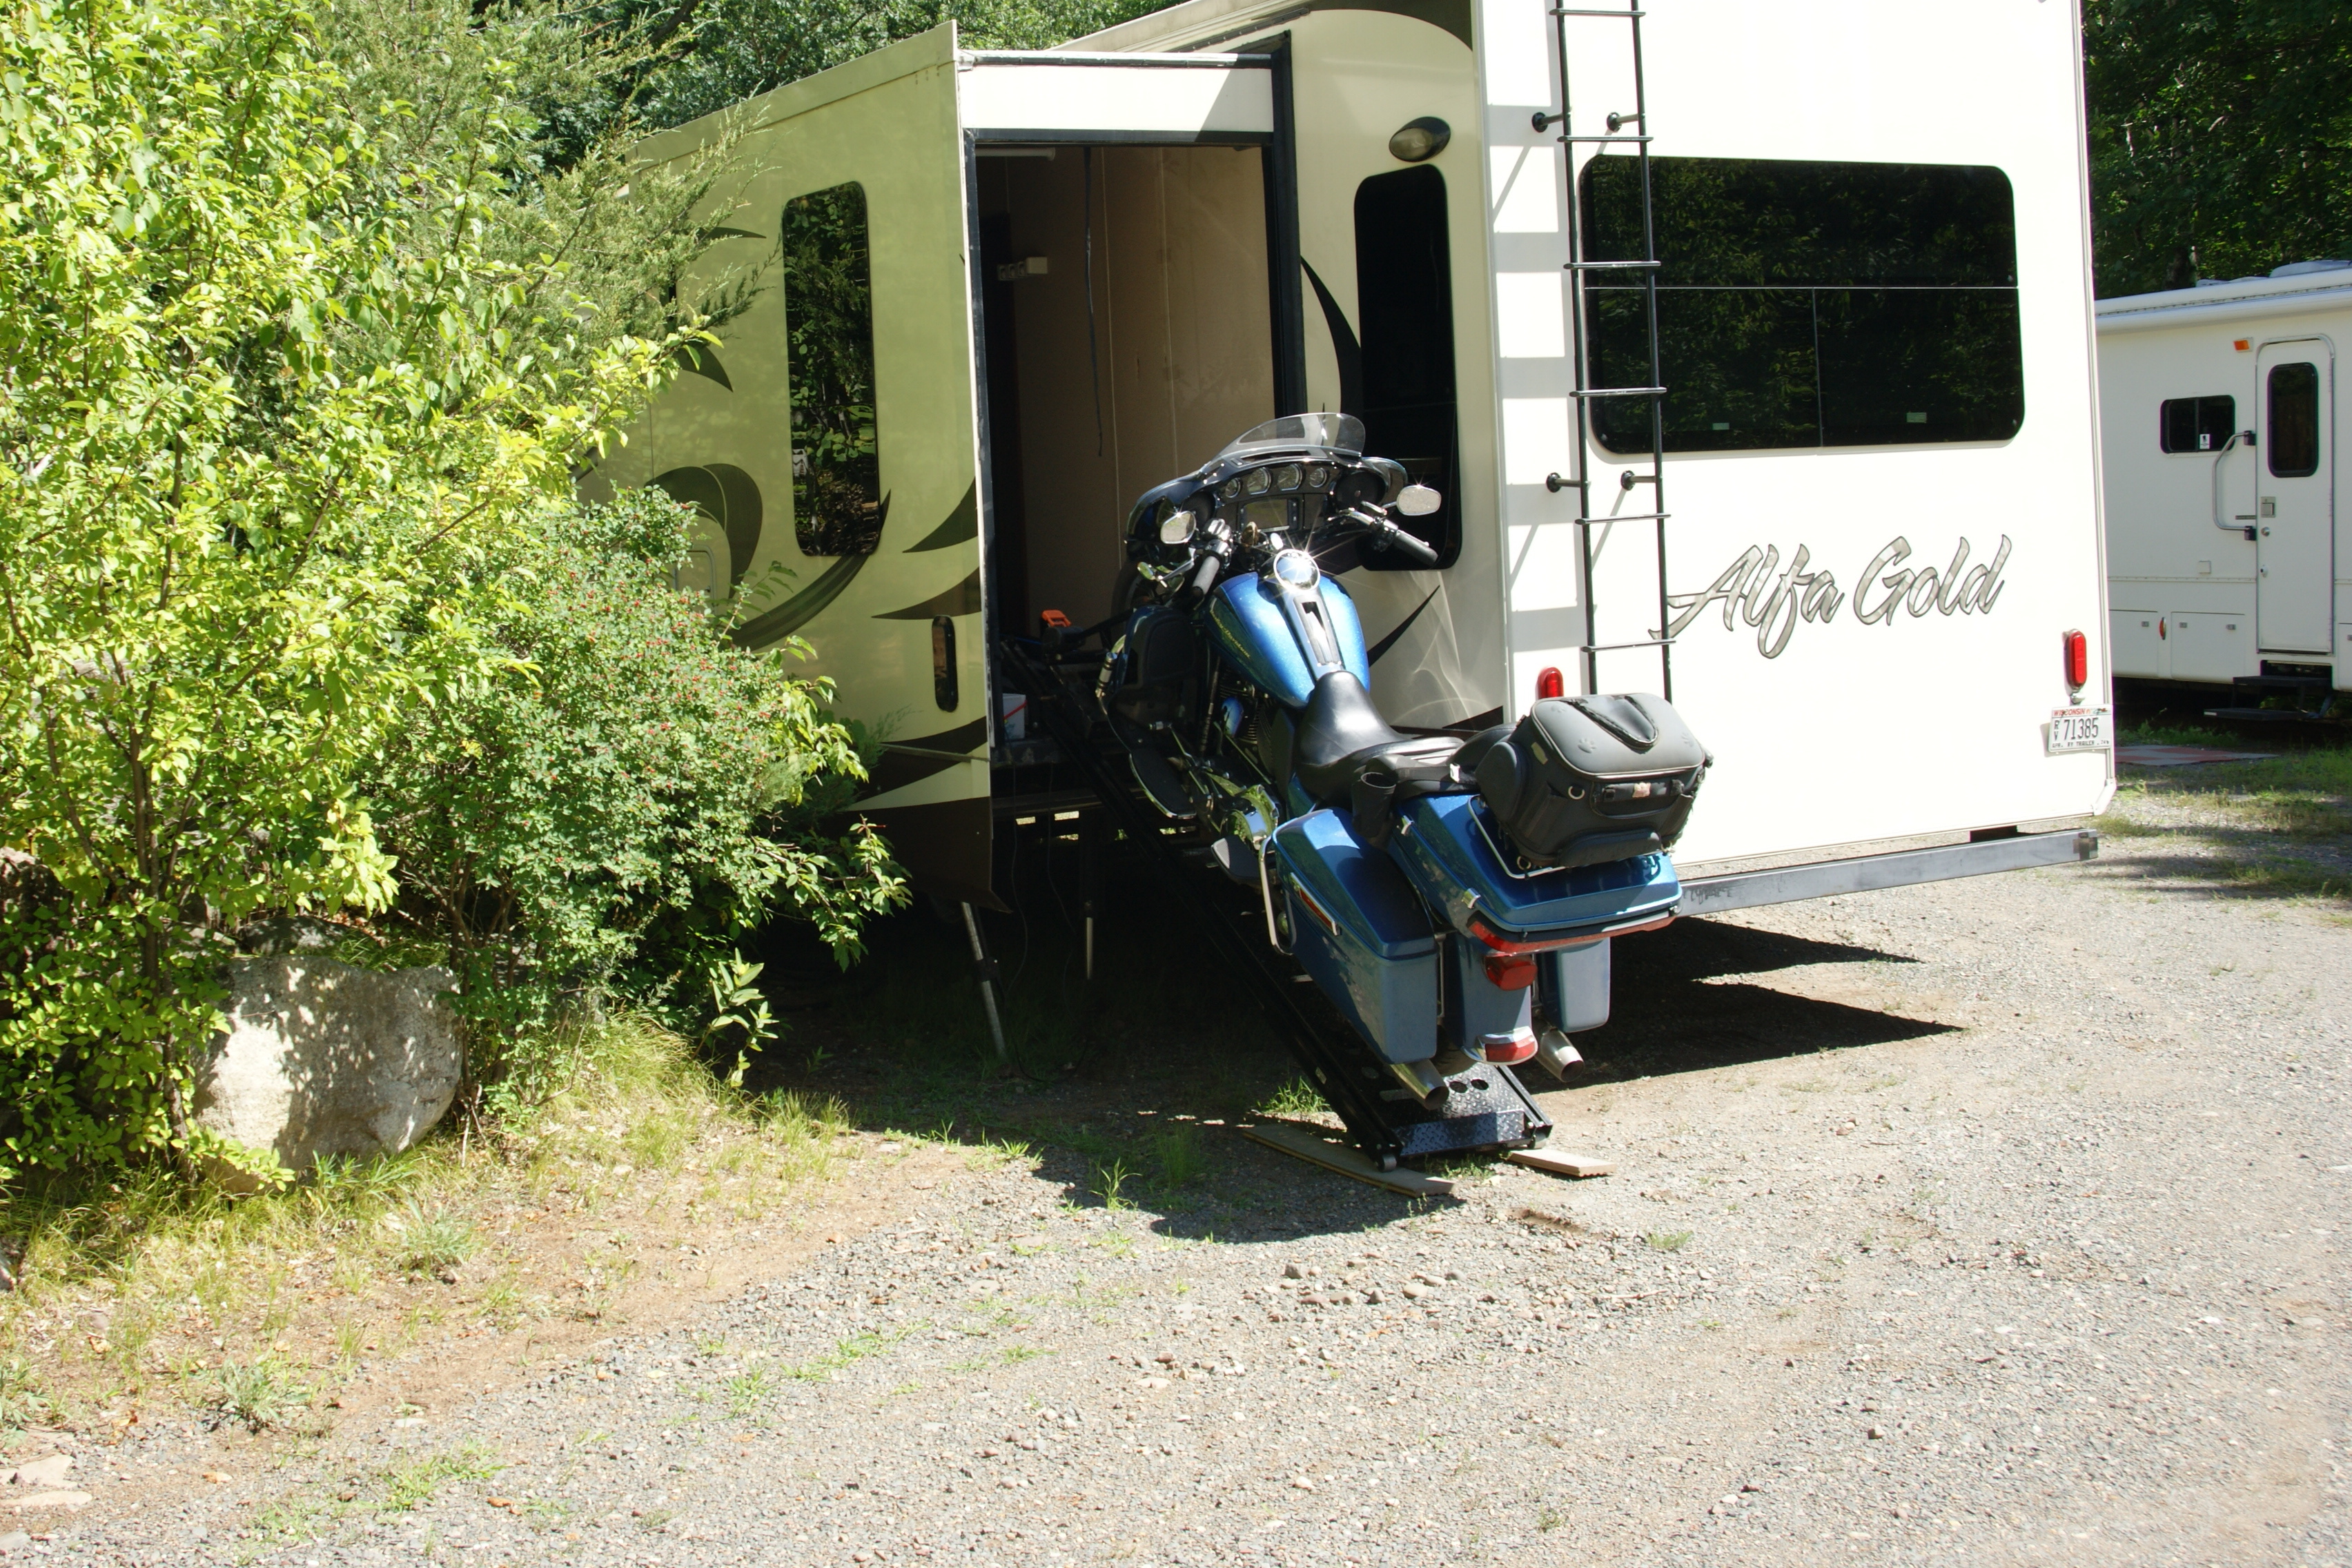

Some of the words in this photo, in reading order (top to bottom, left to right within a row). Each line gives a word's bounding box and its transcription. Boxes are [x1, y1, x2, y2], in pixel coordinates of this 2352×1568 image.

[1648, 543, 1845, 660] Alfa
[1854, 533, 2012, 626] Gold
[2064, 717, 2099, 740] 71385
